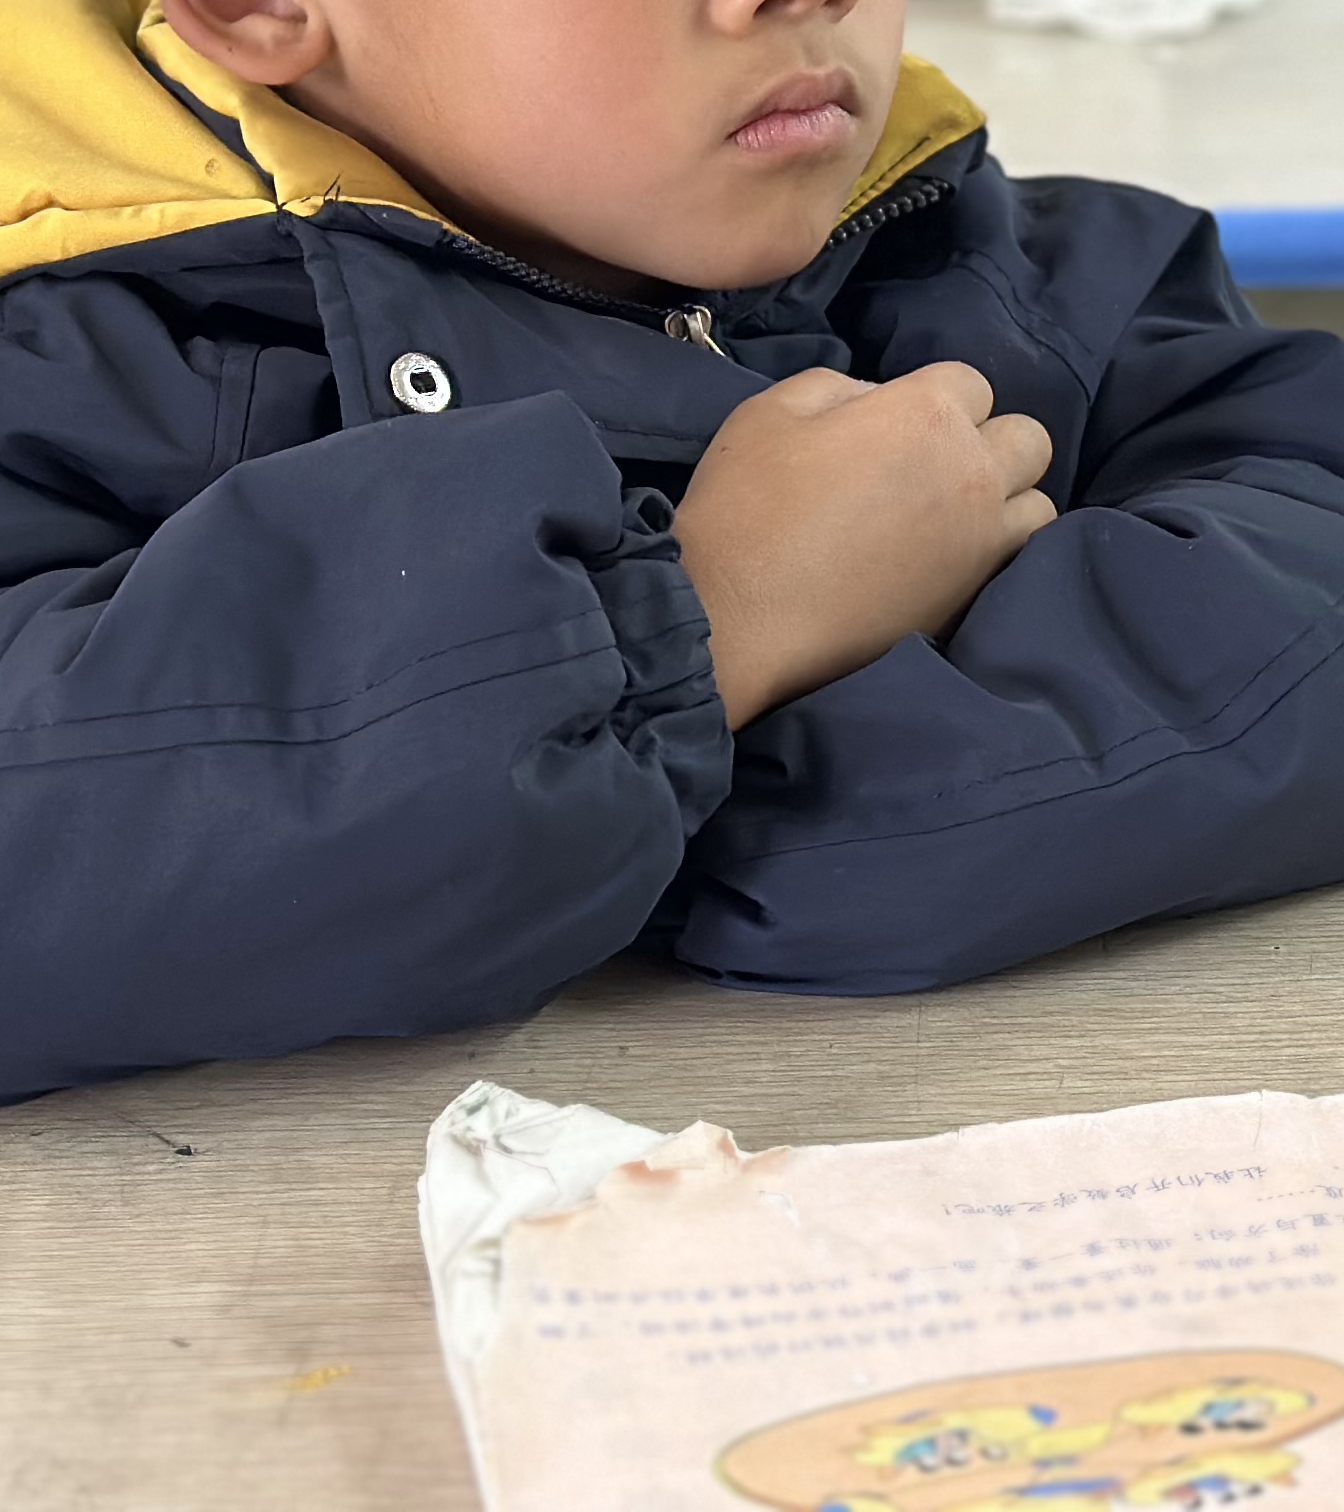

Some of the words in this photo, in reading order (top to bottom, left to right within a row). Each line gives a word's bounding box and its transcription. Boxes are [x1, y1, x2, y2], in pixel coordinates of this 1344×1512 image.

[942, 1165, 1267, 1217] 让我们开启数学之旅吧！
